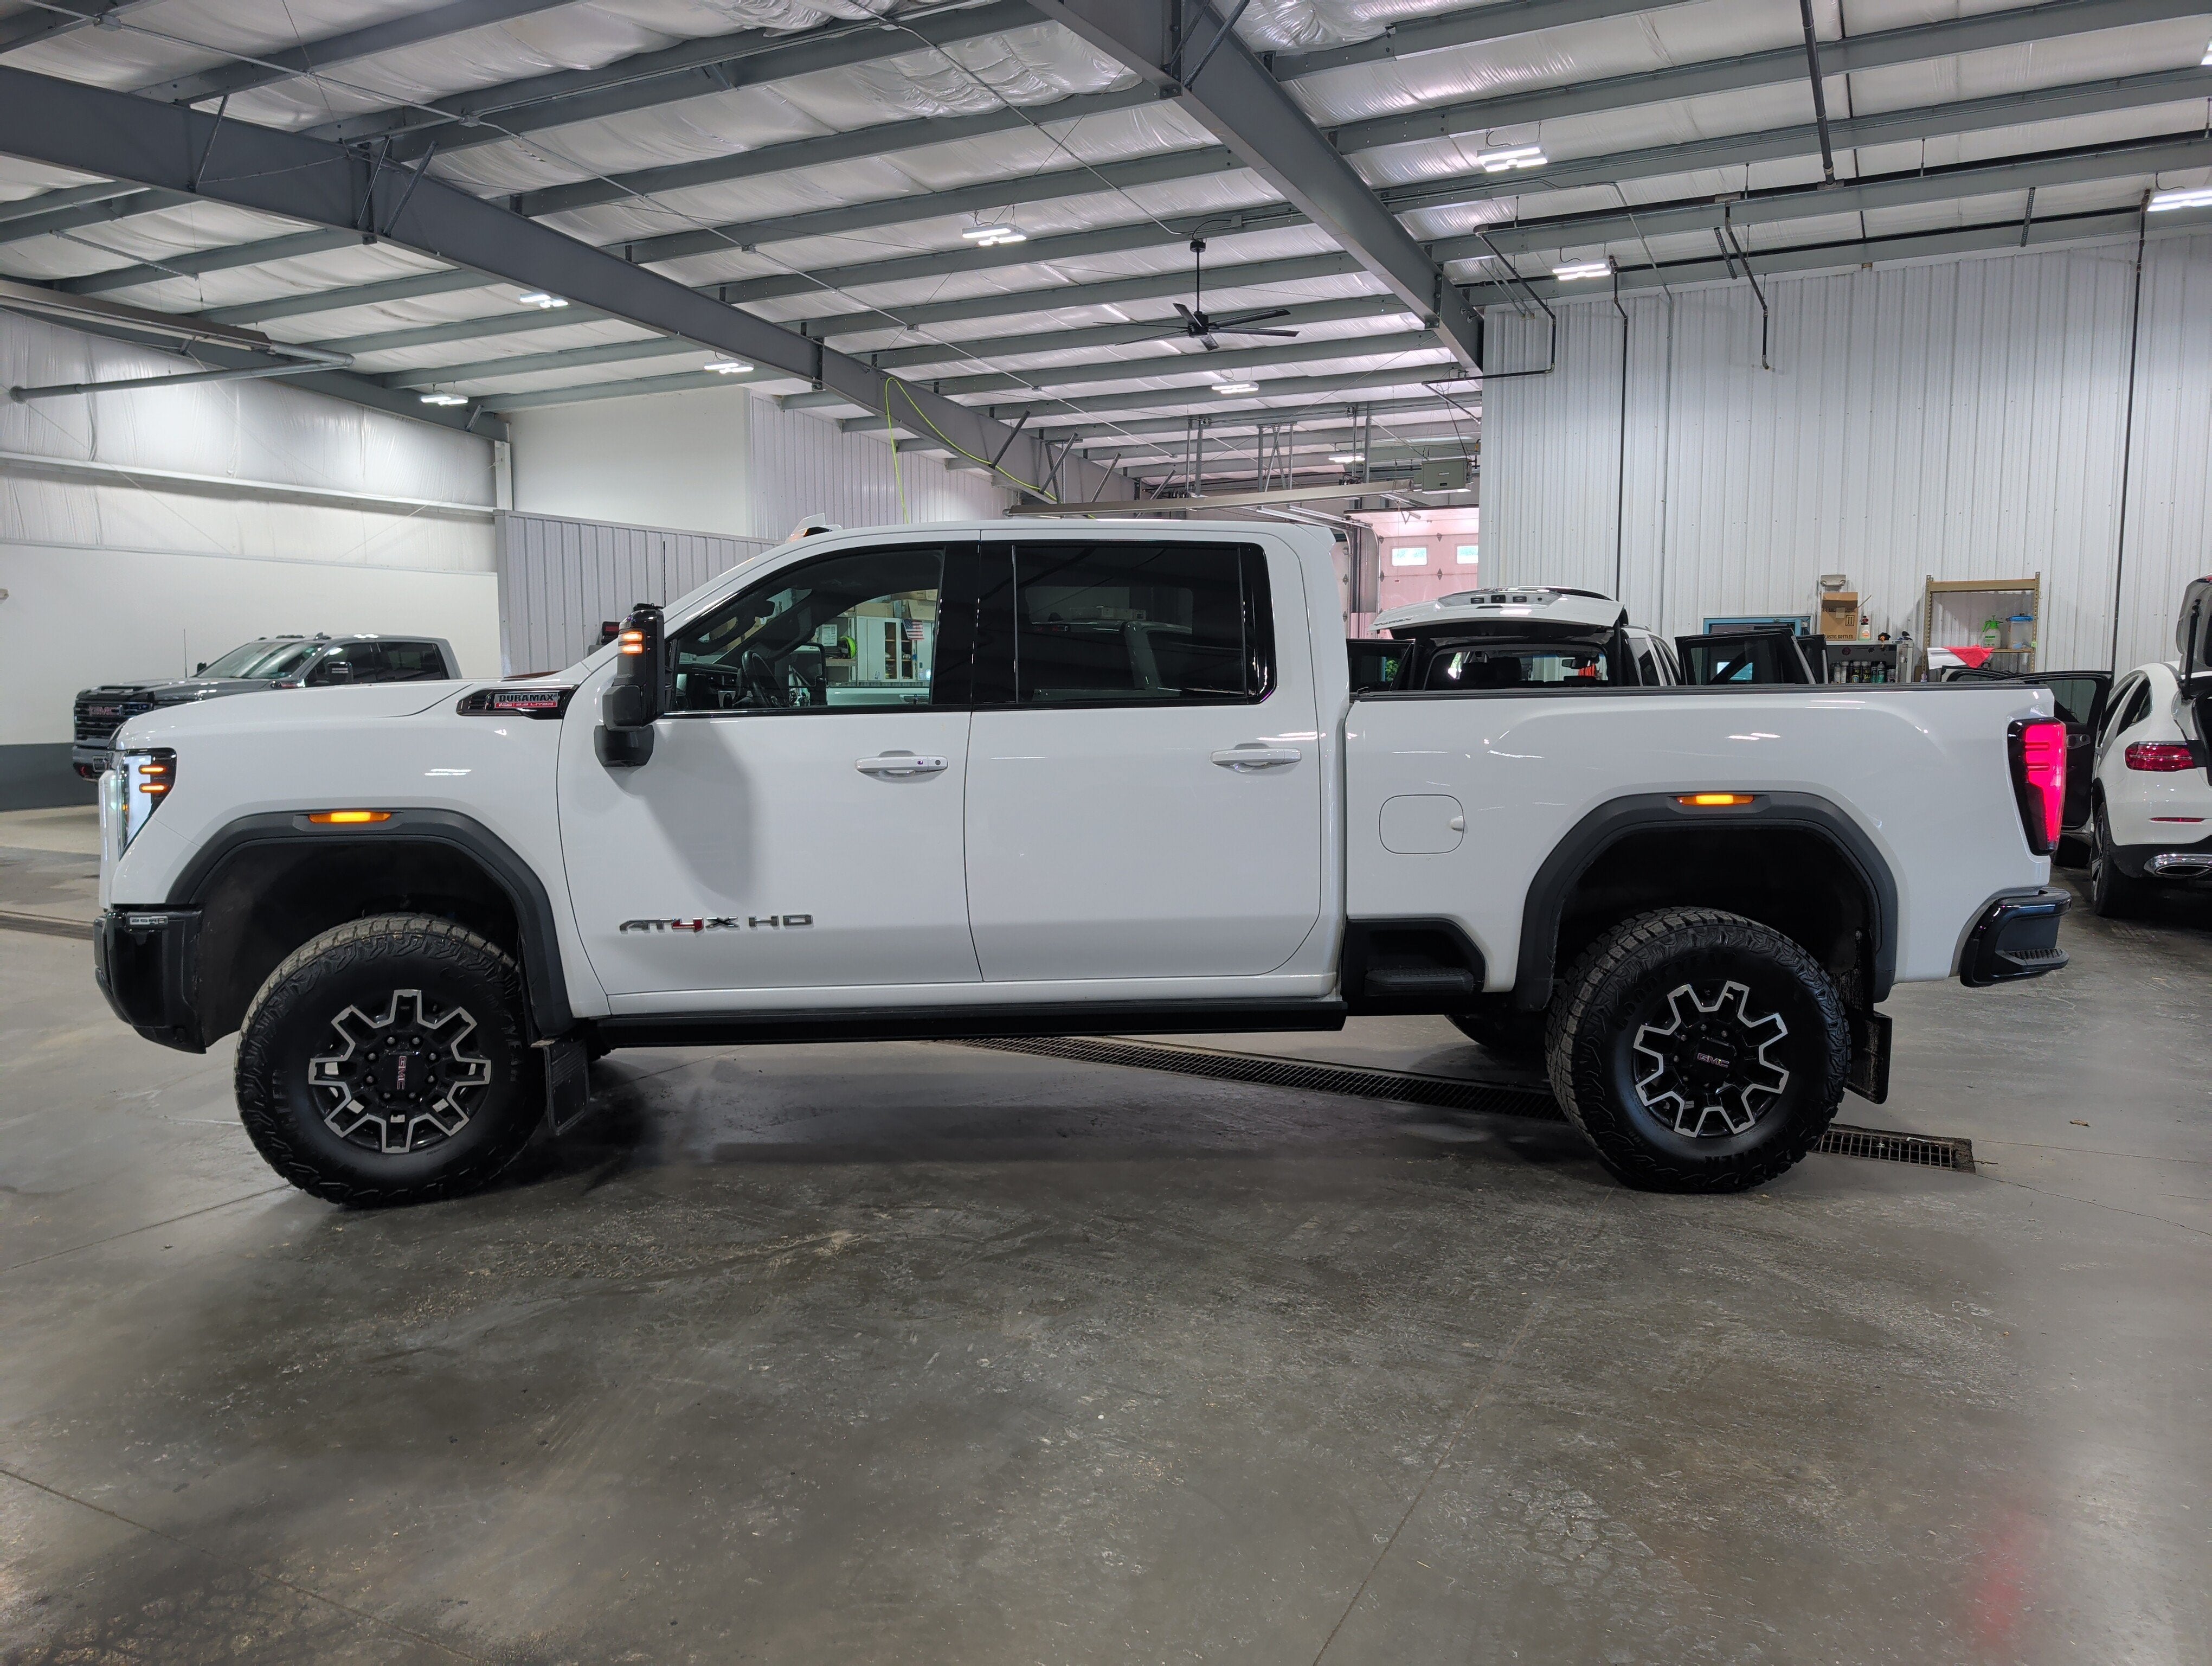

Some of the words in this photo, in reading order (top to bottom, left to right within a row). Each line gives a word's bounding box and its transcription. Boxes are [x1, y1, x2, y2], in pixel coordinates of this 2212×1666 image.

[499, 694, 554, 702] DURAMAX
[620, 915, 740, 934] AT4X
[749, 914, 814, 928] HD
[1697, 1052, 1730, 1068] GMC
[396, 1055, 407, 1091] GMC
